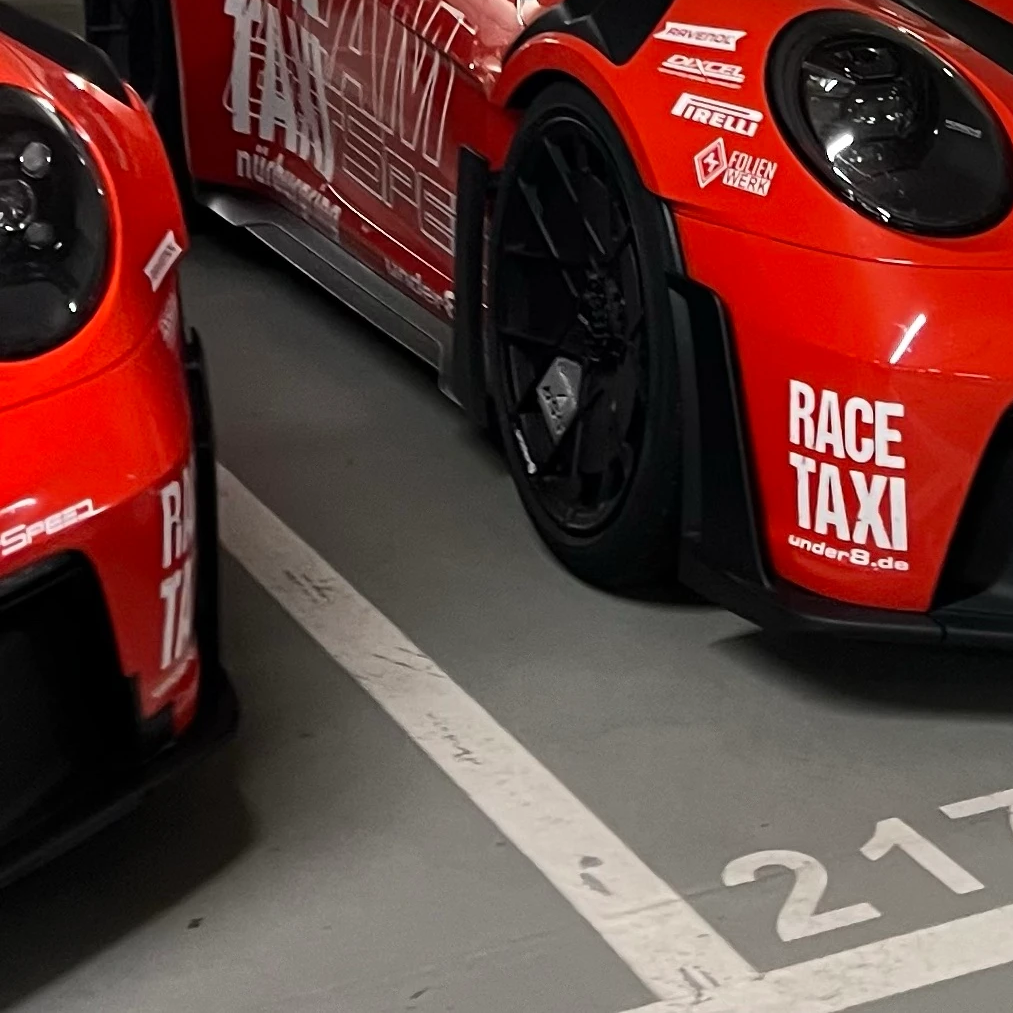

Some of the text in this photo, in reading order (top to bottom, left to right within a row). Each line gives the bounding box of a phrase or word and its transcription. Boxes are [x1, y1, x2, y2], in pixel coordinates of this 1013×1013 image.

[671, 92, 764, 137] PIRELLI
[723, 169, 771, 196] WERK
[728, 150, 778, 180] FOLIEN
[789, 378, 906, 469] RACE
[788, 451, 908, 551] TAXI
[788, 534, 910, 571] under8.de
